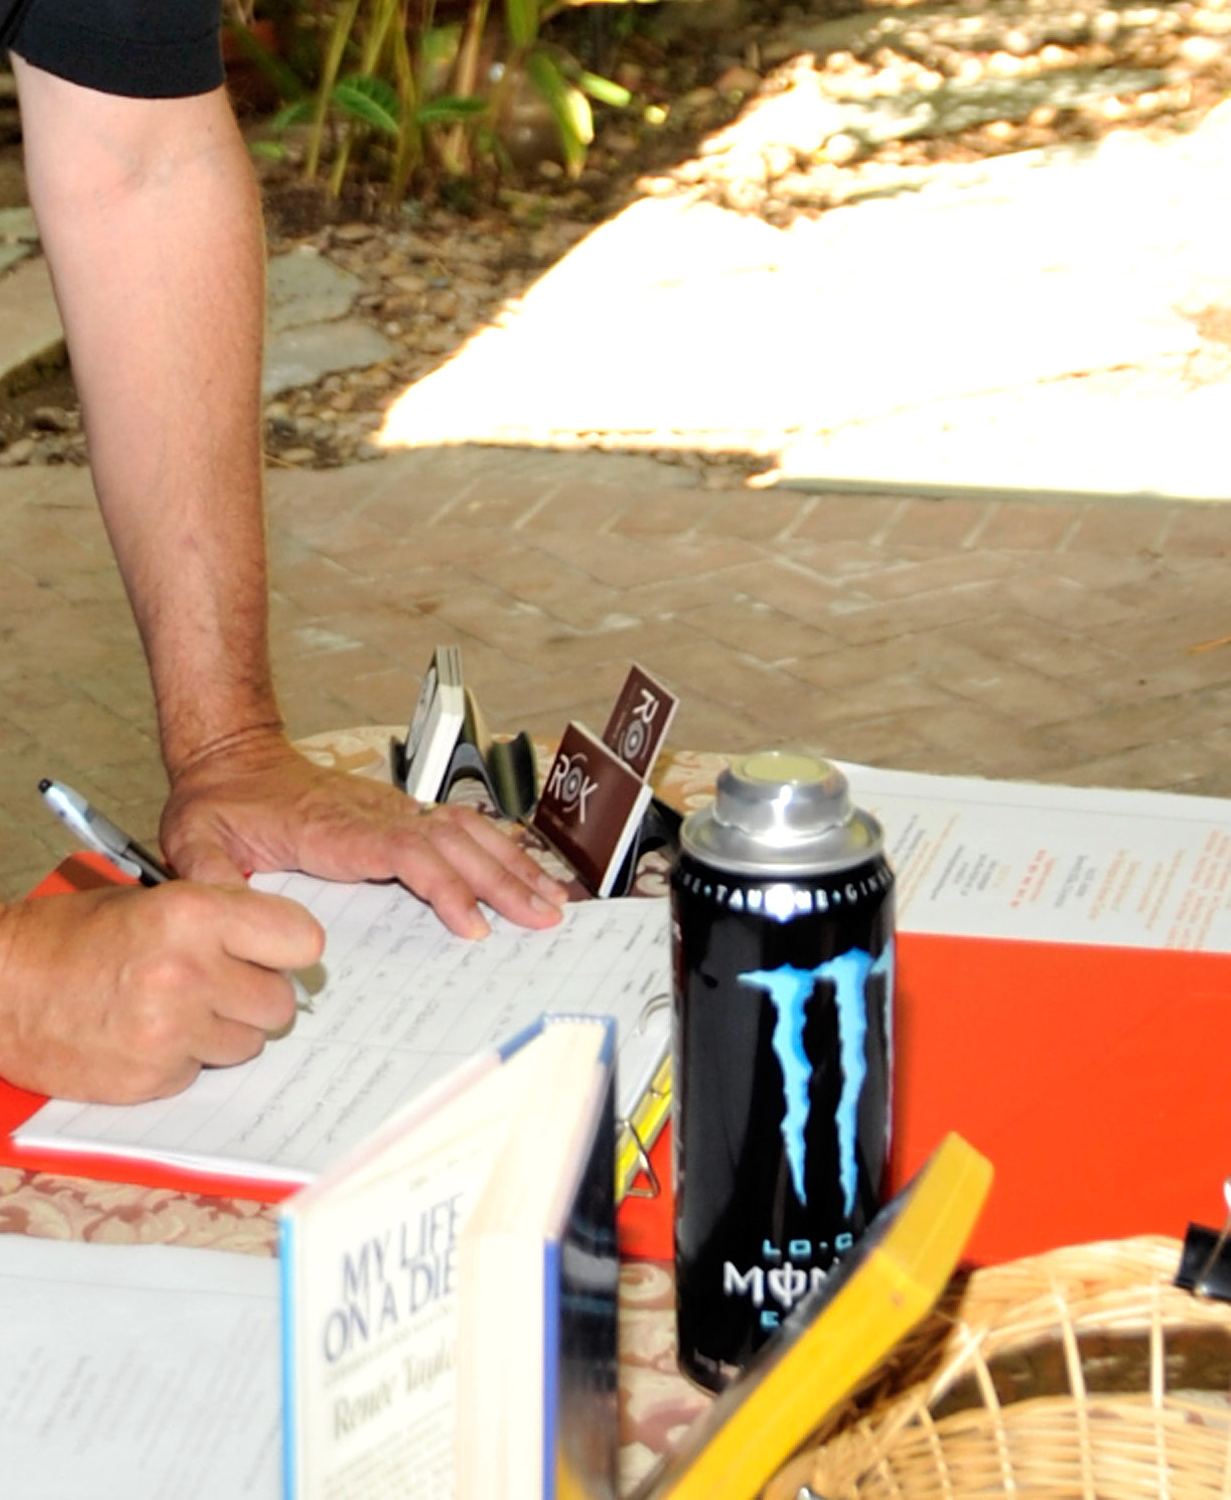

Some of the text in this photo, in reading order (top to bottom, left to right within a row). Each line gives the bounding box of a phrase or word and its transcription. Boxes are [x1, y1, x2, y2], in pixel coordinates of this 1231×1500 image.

[342, 1192, 464, 1310] MY LIFE
[322, 1301, 369, 1365] ON
[377, 1281, 399, 1335] A
